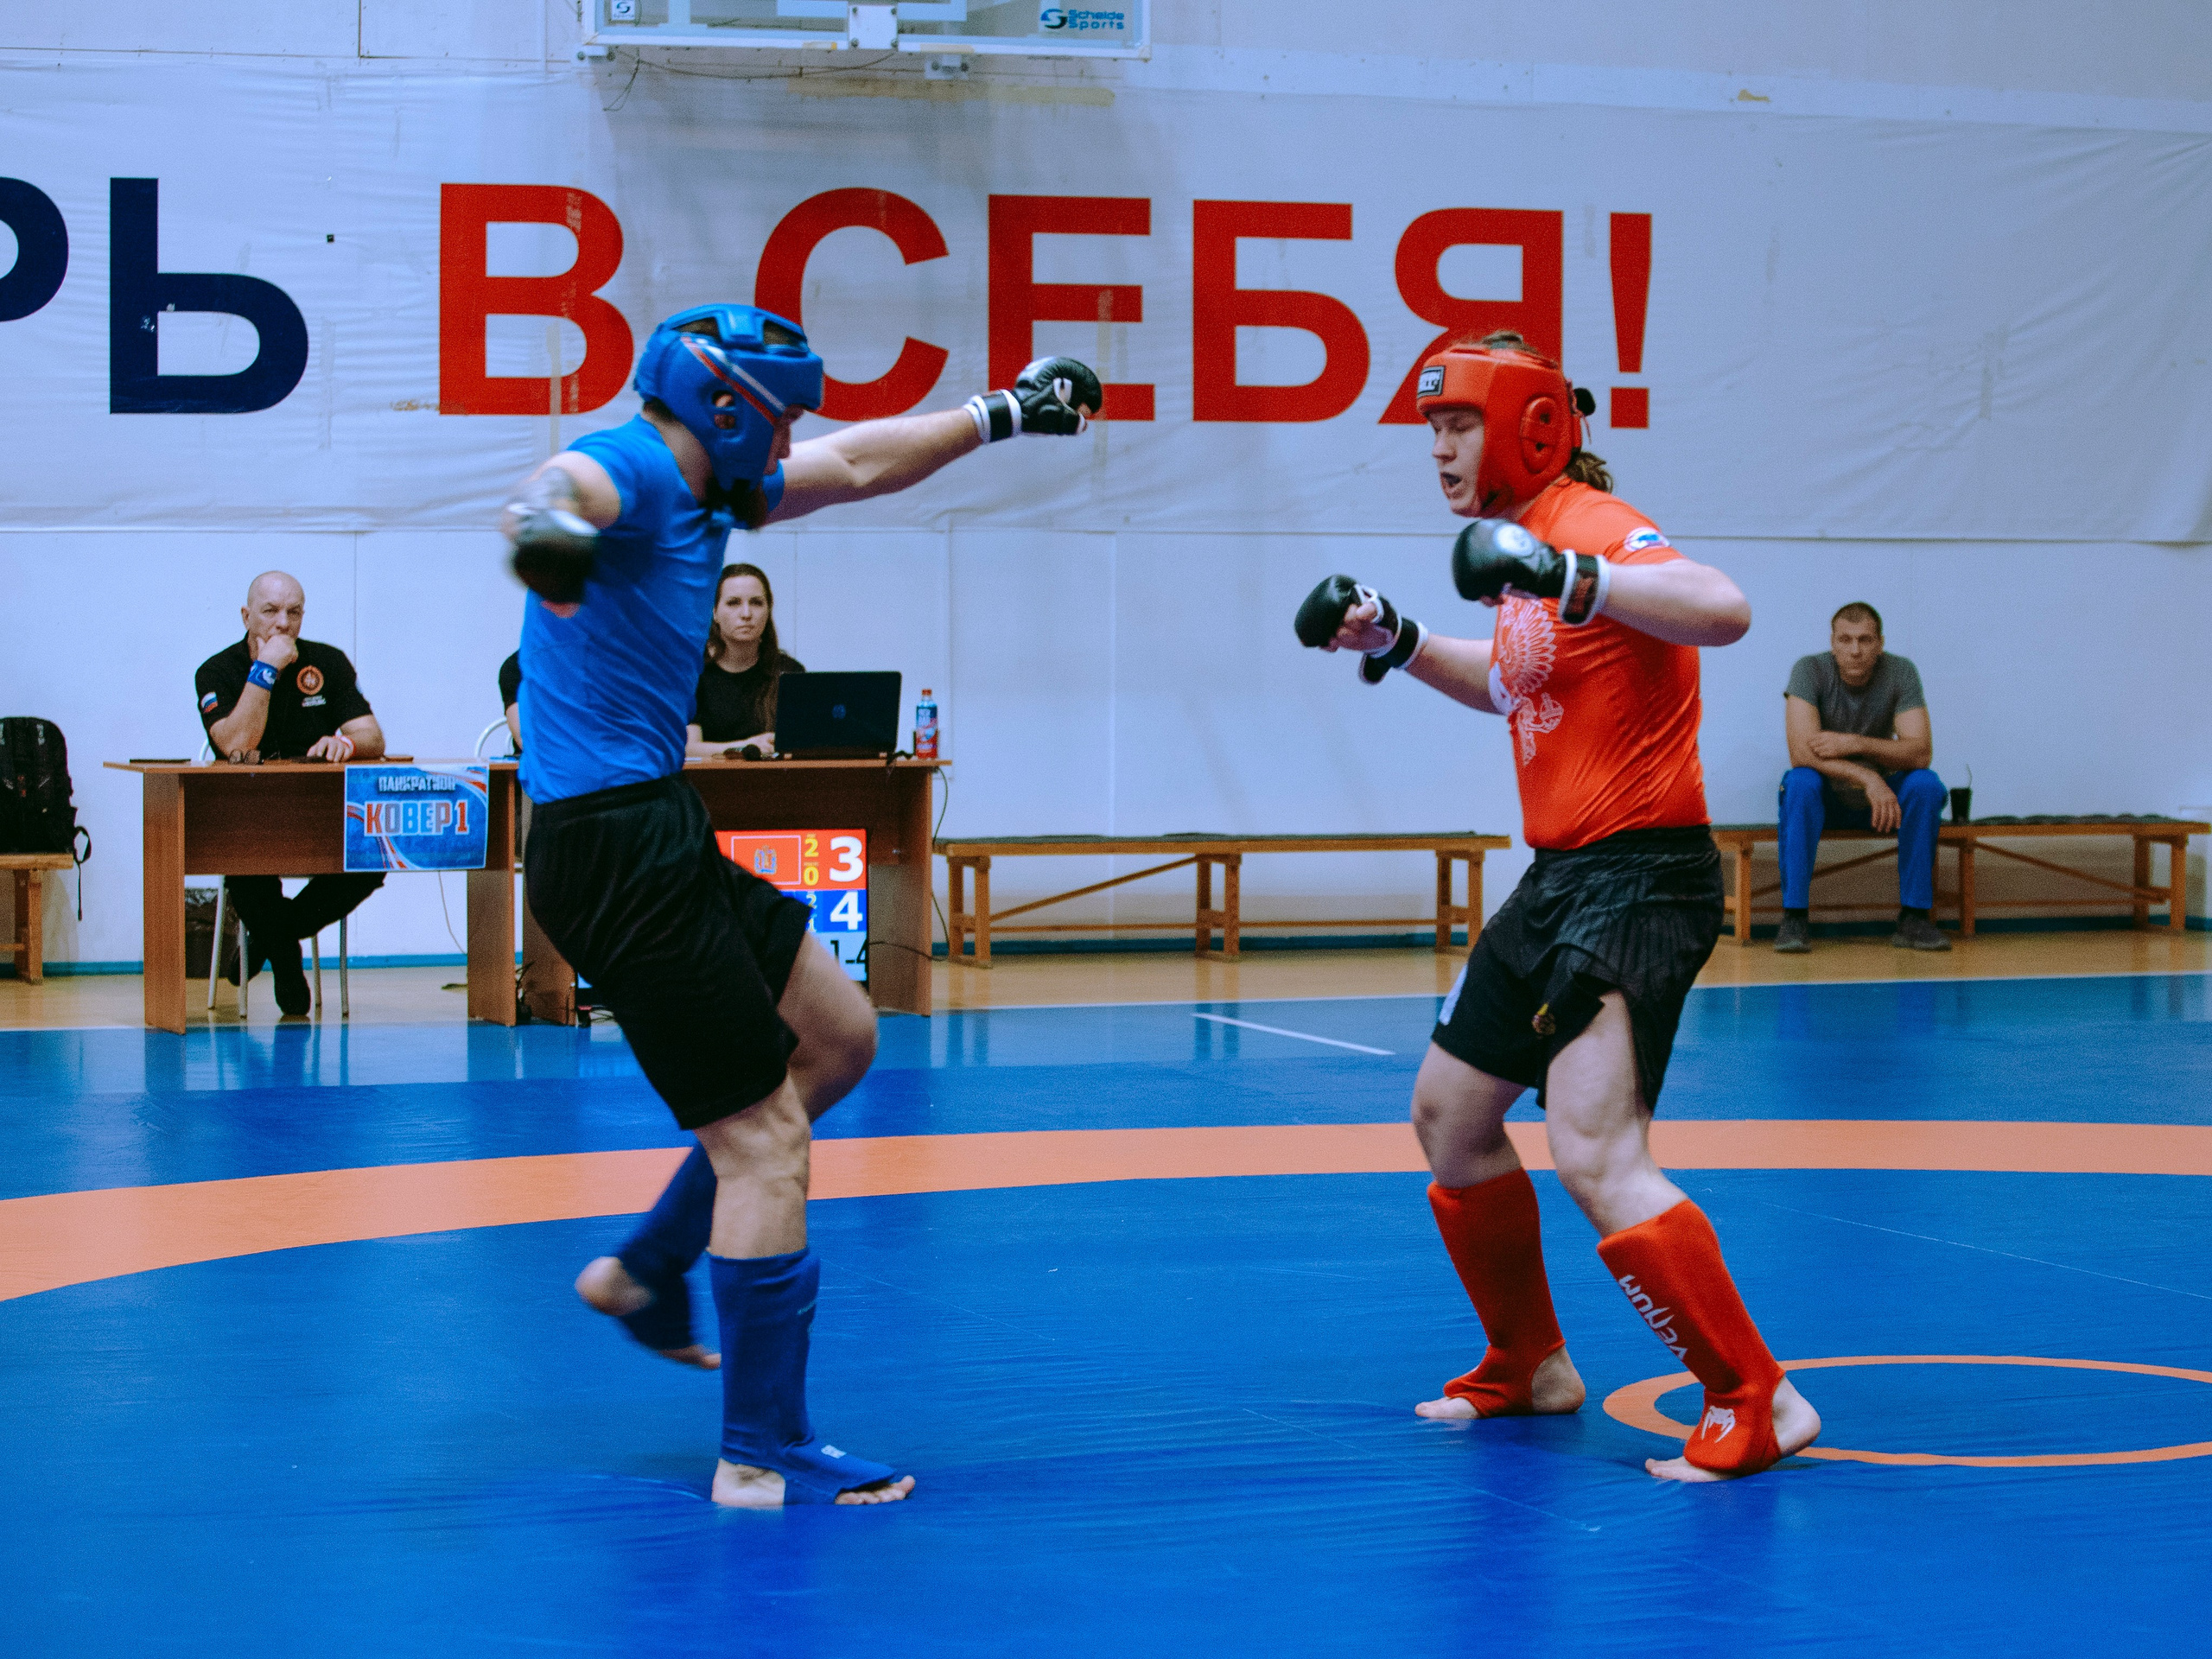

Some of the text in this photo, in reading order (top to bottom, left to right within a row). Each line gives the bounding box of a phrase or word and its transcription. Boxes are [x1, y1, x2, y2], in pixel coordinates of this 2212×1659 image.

[1068, 20, 1125, 30] Sports
[439, 183, 634, 416] В
[754, 188, 1652, 429] СЕБЯ!
[378, 776, 456, 792] ПАНКРАТИОН
[365, 801, 453, 836] КОВЕР
[804, 838, 819, 857] 2
[830, 836, 863, 881] 3
[804, 868, 819, 886] 0
[830, 891, 863, 931] 4
[1618, 1274, 1688, 1361] VENUM
